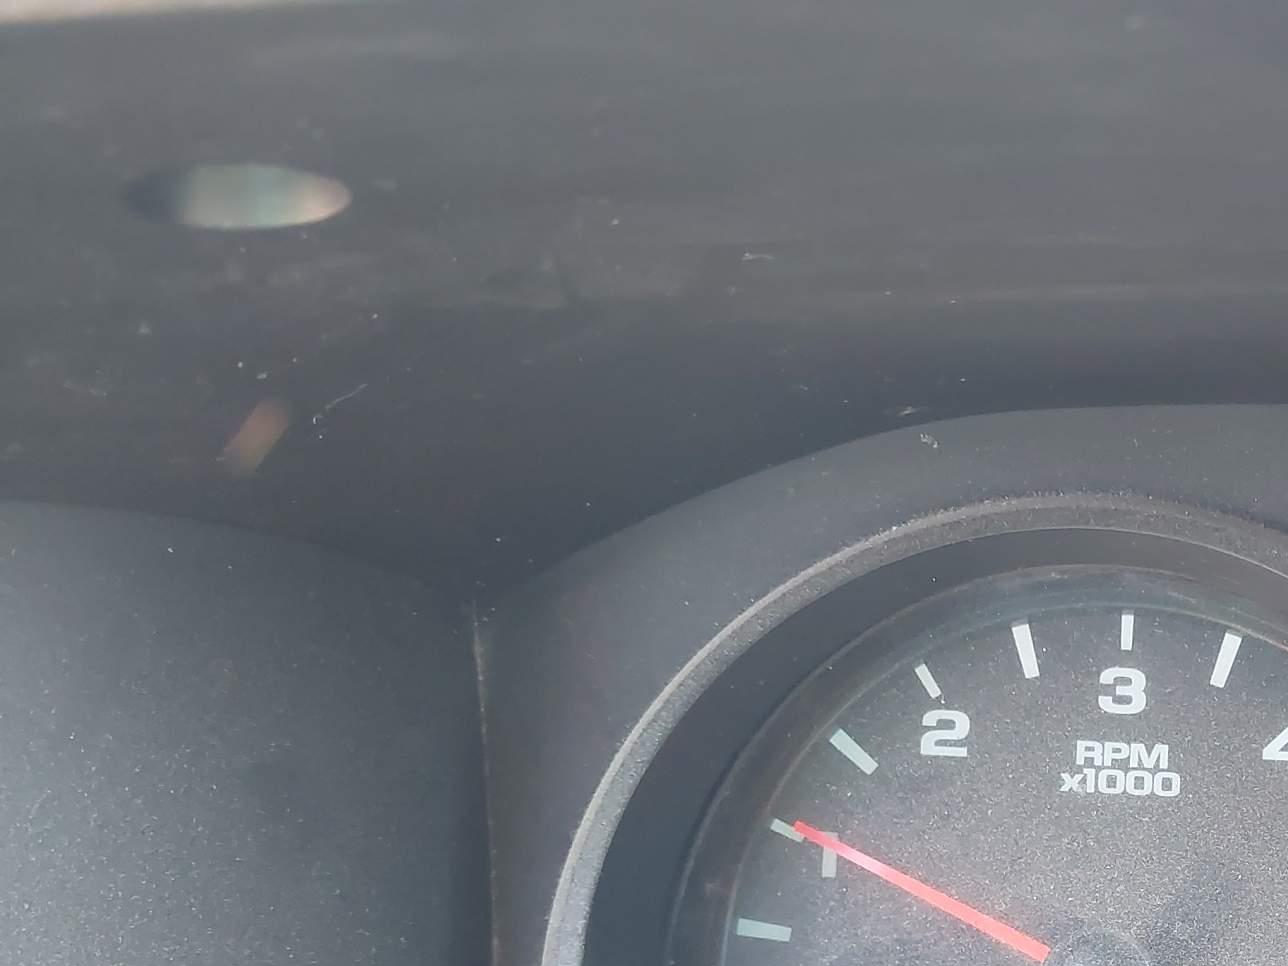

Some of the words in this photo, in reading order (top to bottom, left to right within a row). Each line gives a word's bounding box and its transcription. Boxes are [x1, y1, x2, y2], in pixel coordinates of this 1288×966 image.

[1098, 667, 1147, 716] 3
[920, 709, 970, 758] 2
[1076, 741, 1170, 769] RPM
[1059, 770, 1181, 798] x1000
